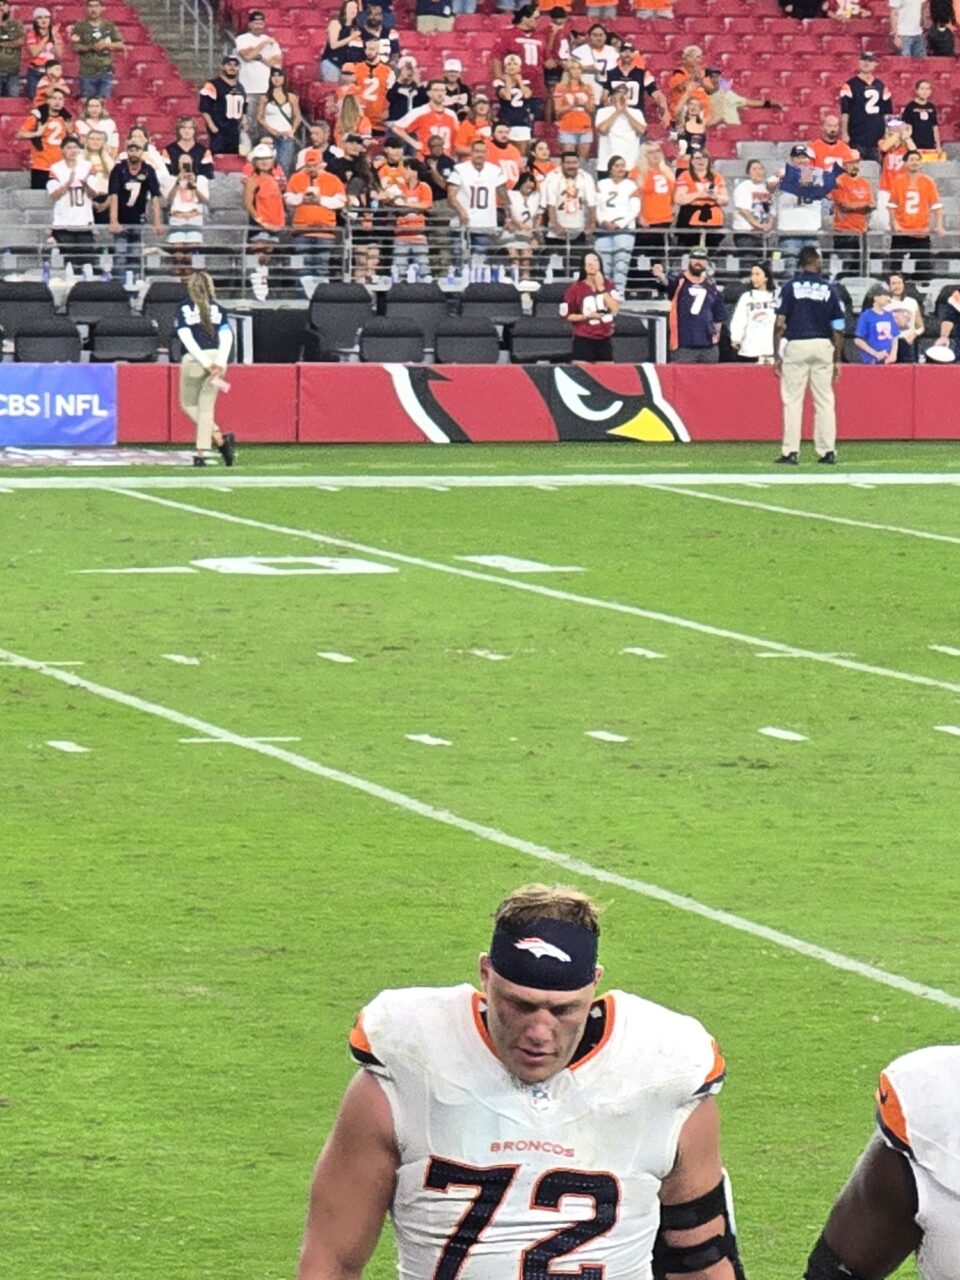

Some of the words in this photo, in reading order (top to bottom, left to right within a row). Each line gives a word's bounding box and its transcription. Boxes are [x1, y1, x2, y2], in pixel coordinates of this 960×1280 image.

[363, 77, 380, 101] 2
[511, 88, 524, 108] 2
[225, 94, 245, 120] 10
[864, 89, 880, 114] 2
[47, 121, 63, 145] 2
[69, 186, 85, 208] 10
[125, 182, 141, 207] 7
[469, 186, 489, 210] 10
[605, 191, 620, 208] 2
[905, 190, 920, 214] 2
[689, 287, 707, 315] 7
[0, 394, 40, 417] CBS
[55, 394, 109, 417] NFL
[490, 1140, 575, 1158] BRONCOS
